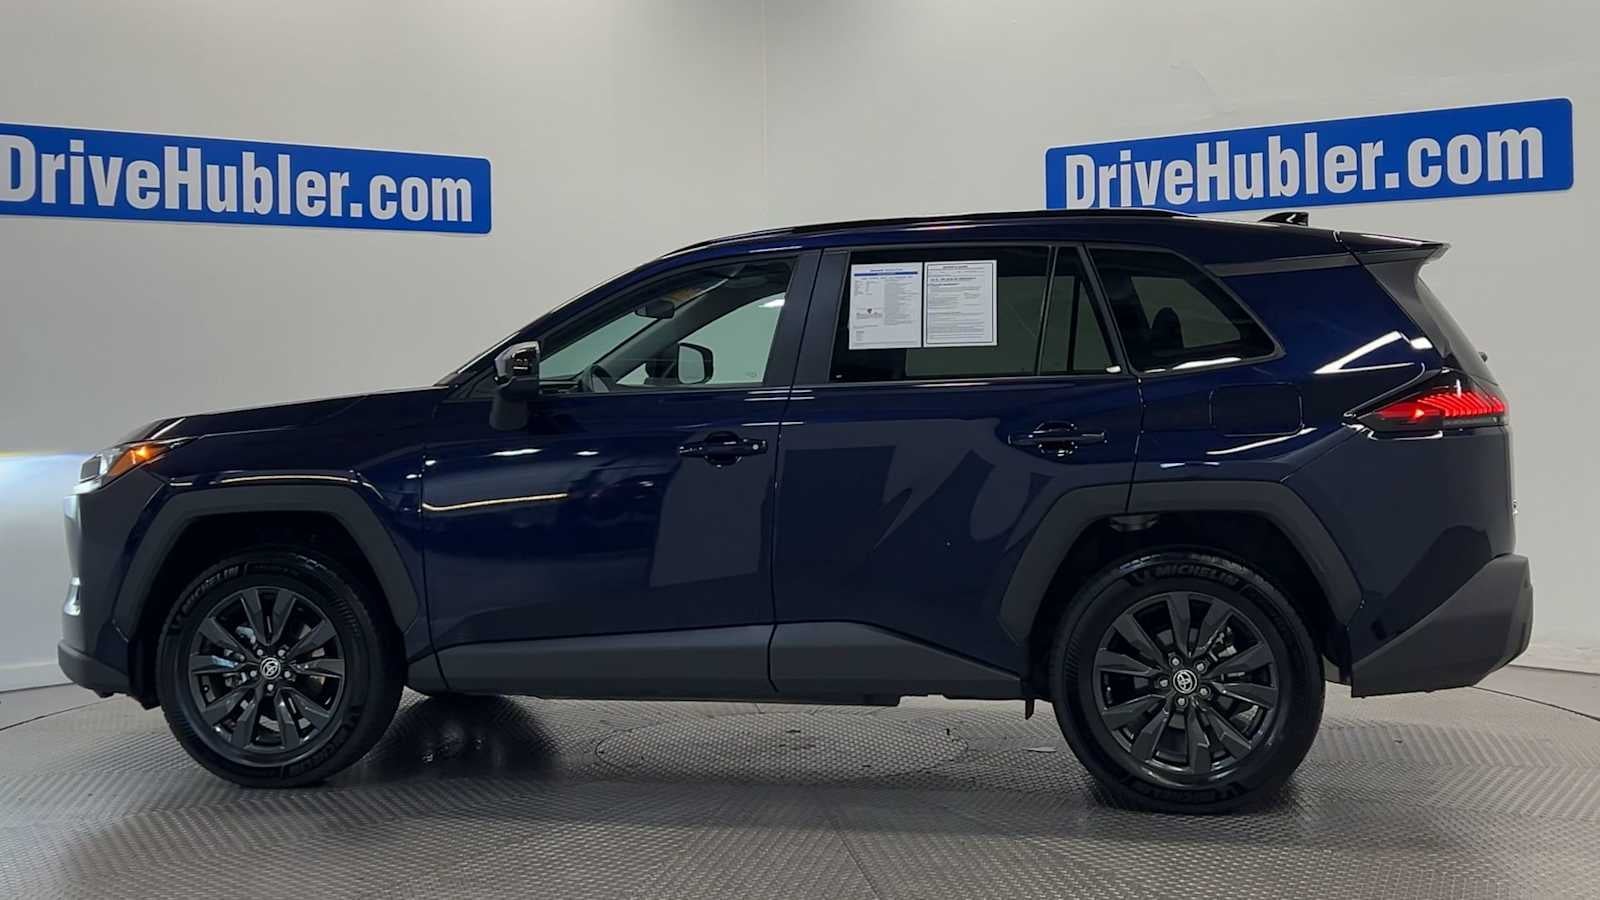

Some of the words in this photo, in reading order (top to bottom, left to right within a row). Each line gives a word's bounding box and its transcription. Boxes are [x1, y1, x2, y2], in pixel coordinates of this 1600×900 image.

[0, 135, 472, 222] DriveHubler.com
[1066, 126, 1543, 209] DriveHubler.com
[1155, 564, 1239, 586] MICHELIN
